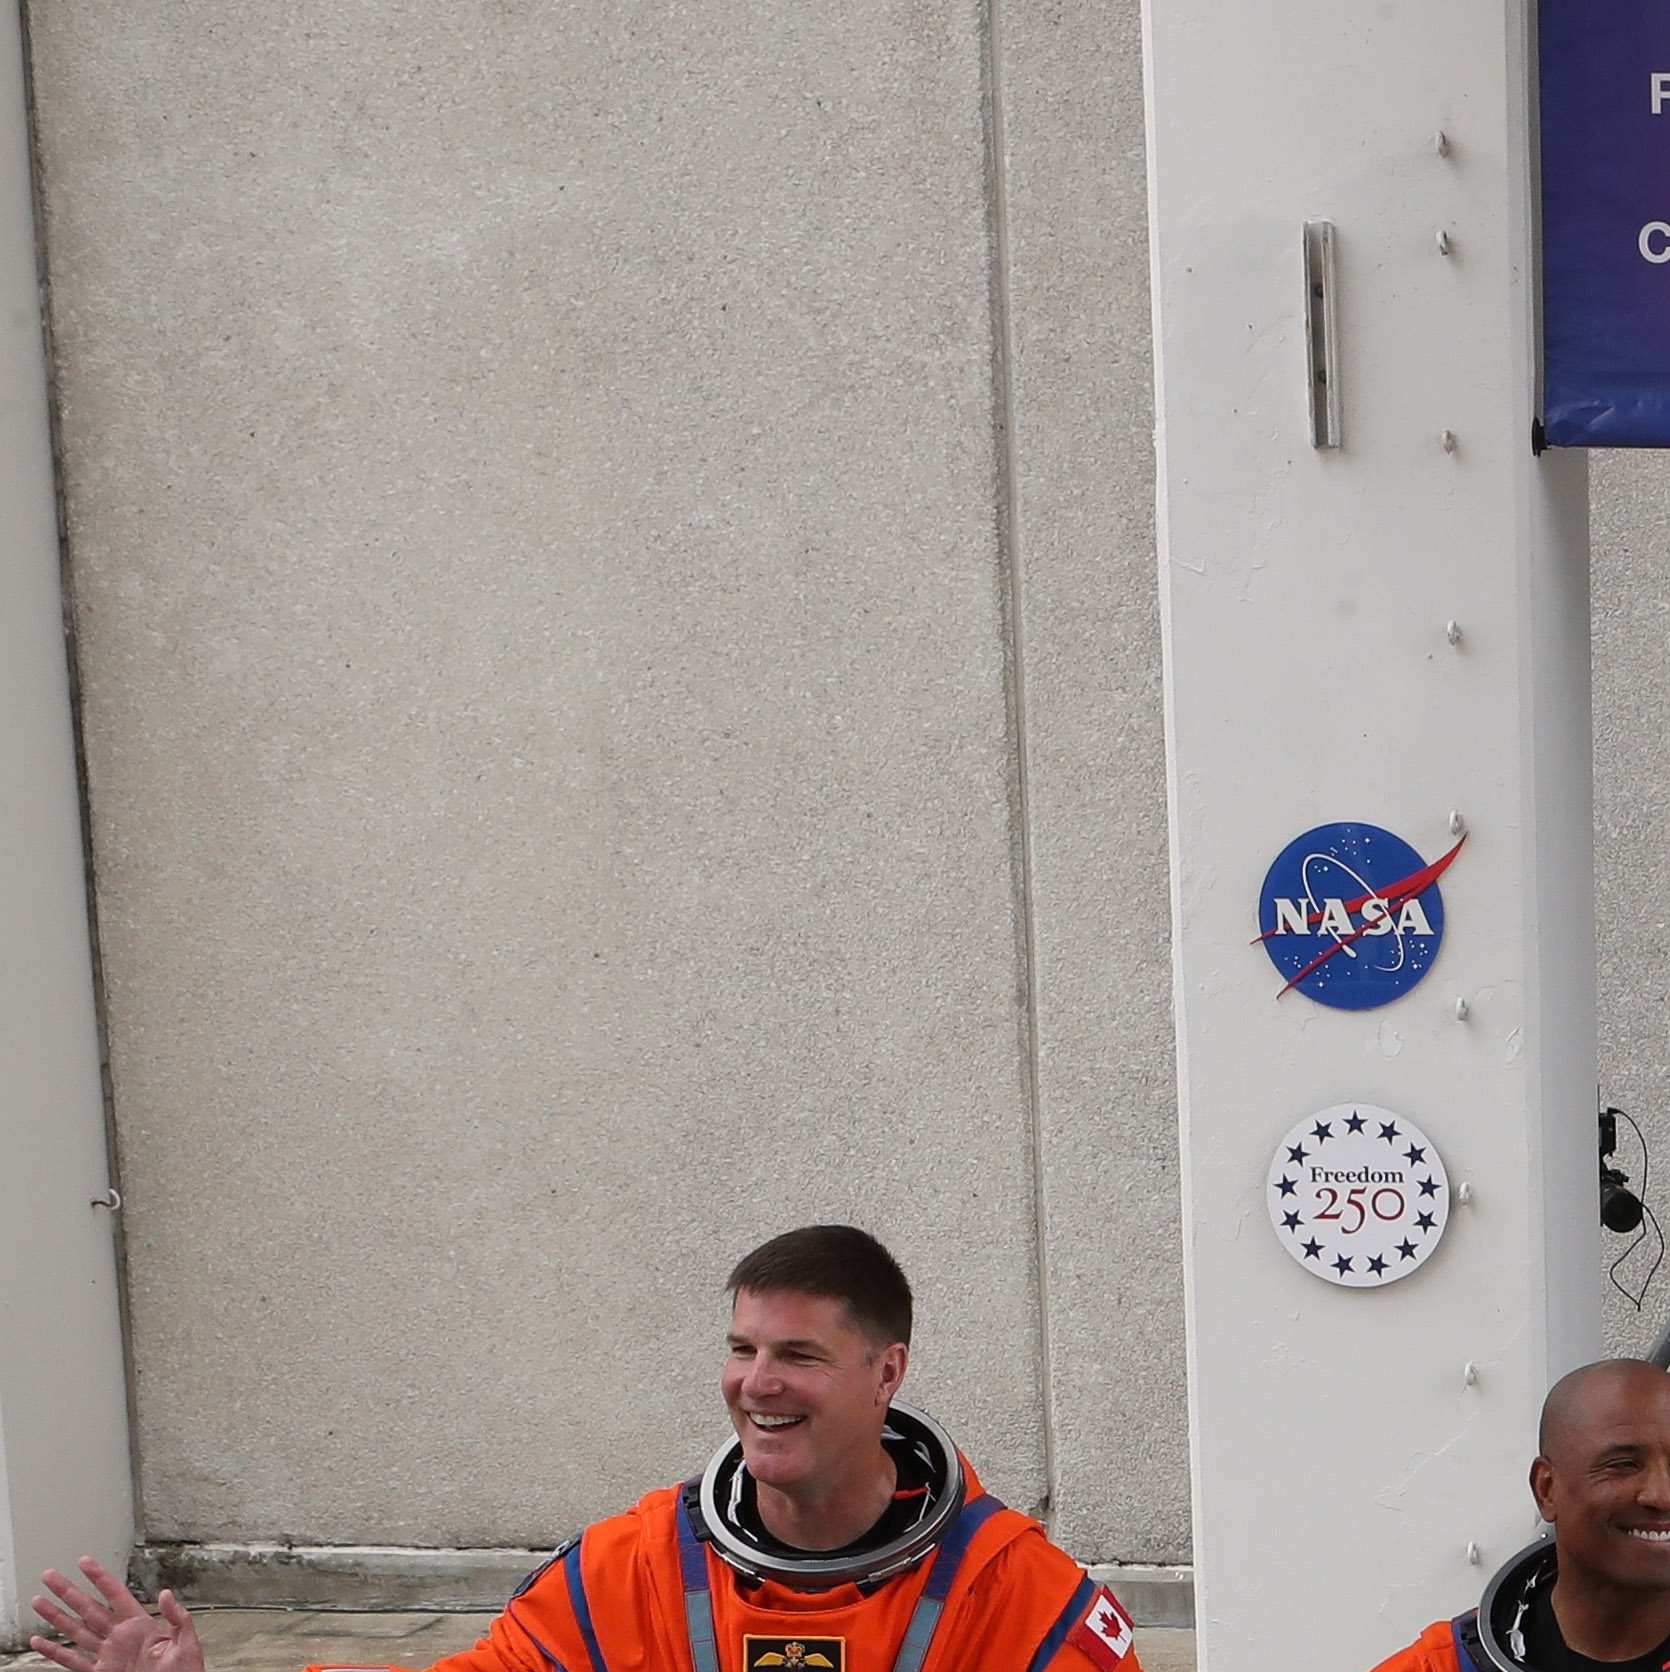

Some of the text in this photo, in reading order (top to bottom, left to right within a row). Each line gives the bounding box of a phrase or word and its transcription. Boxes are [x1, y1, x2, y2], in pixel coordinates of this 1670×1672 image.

[1274, 898, 1435, 936] NASA
[1310, 1166, 1405, 1184] Freedom
[1313, 1186, 1406, 1235] 250
